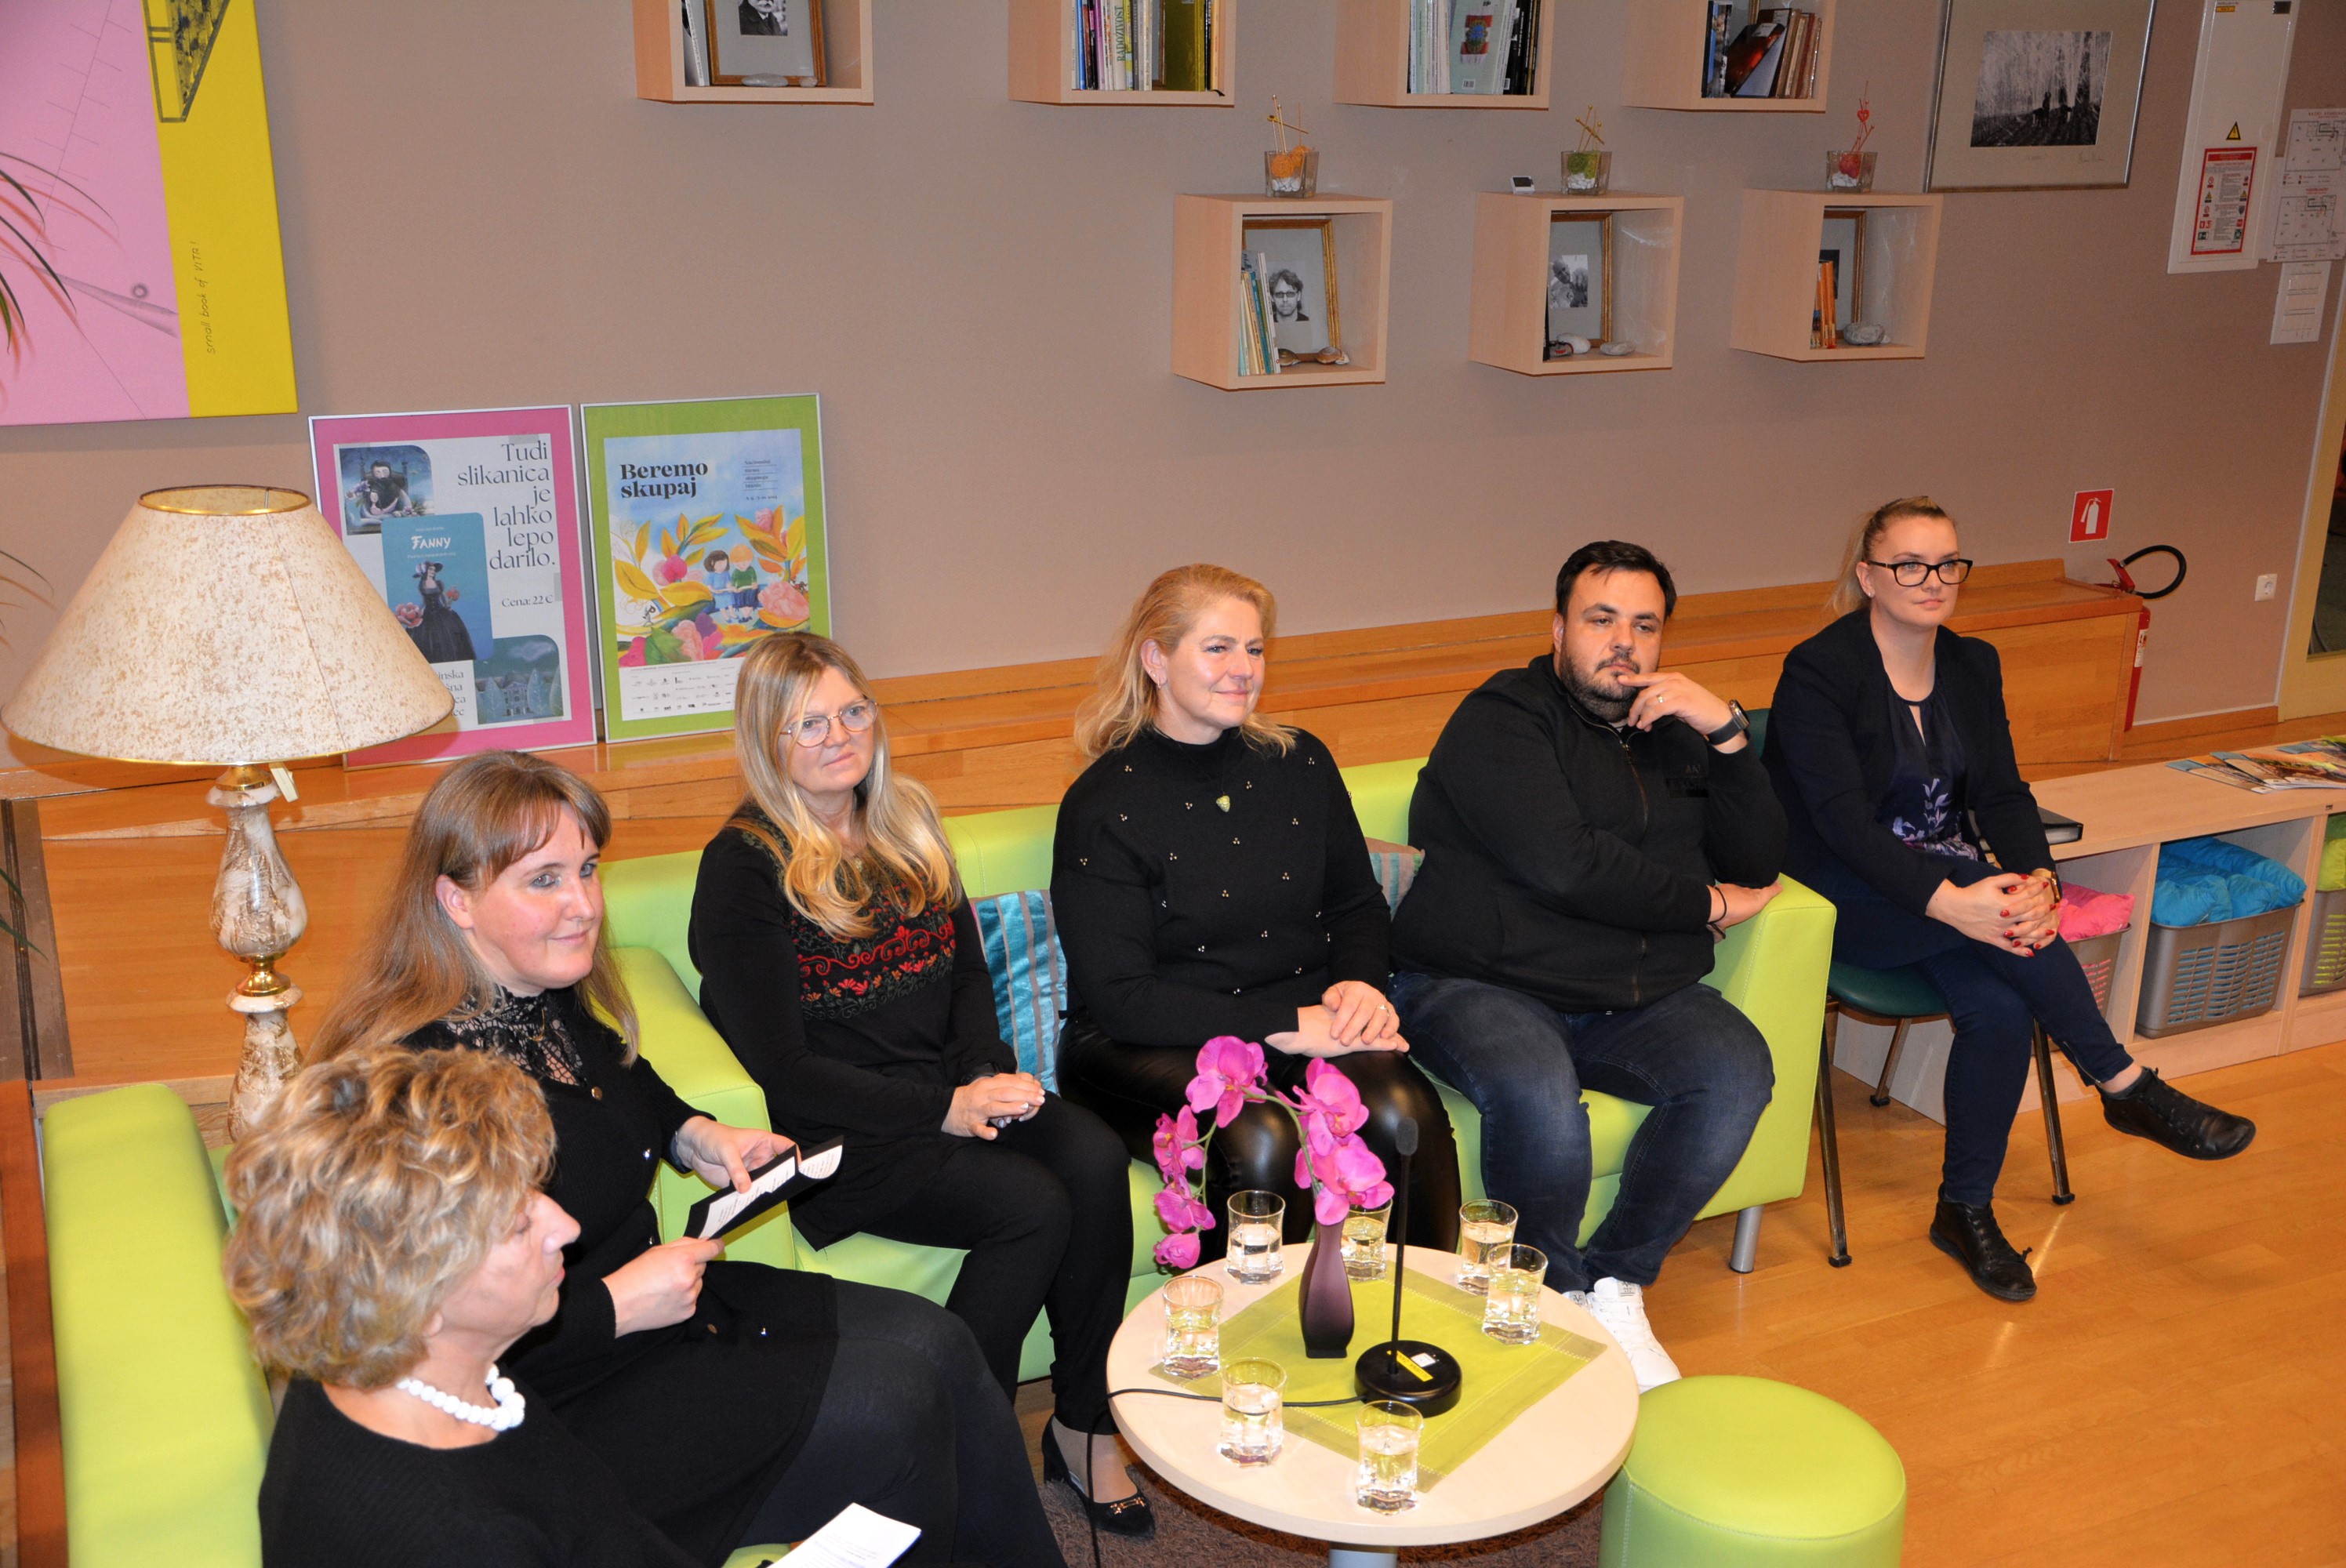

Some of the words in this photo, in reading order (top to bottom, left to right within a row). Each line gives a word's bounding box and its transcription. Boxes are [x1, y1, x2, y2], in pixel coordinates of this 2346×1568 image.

[194, 277, 209, 288] of
[195, 293, 209, 318] book
[200, 321, 216, 354] small
[501, 440, 549, 462] Tudi
[457, 465, 550, 486] slikanica
[620, 462, 709, 481] Beremo
[531, 485, 551, 510] je
[620, 477, 698, 499] skupaj
[493, 504, 553, 527] lahko
[507, 527, 554, 552] lepo
[489, 547, 556, 570] darilo.
[501, 597, 531, 608] Cena:
[532, 595, 544, 605] 22
